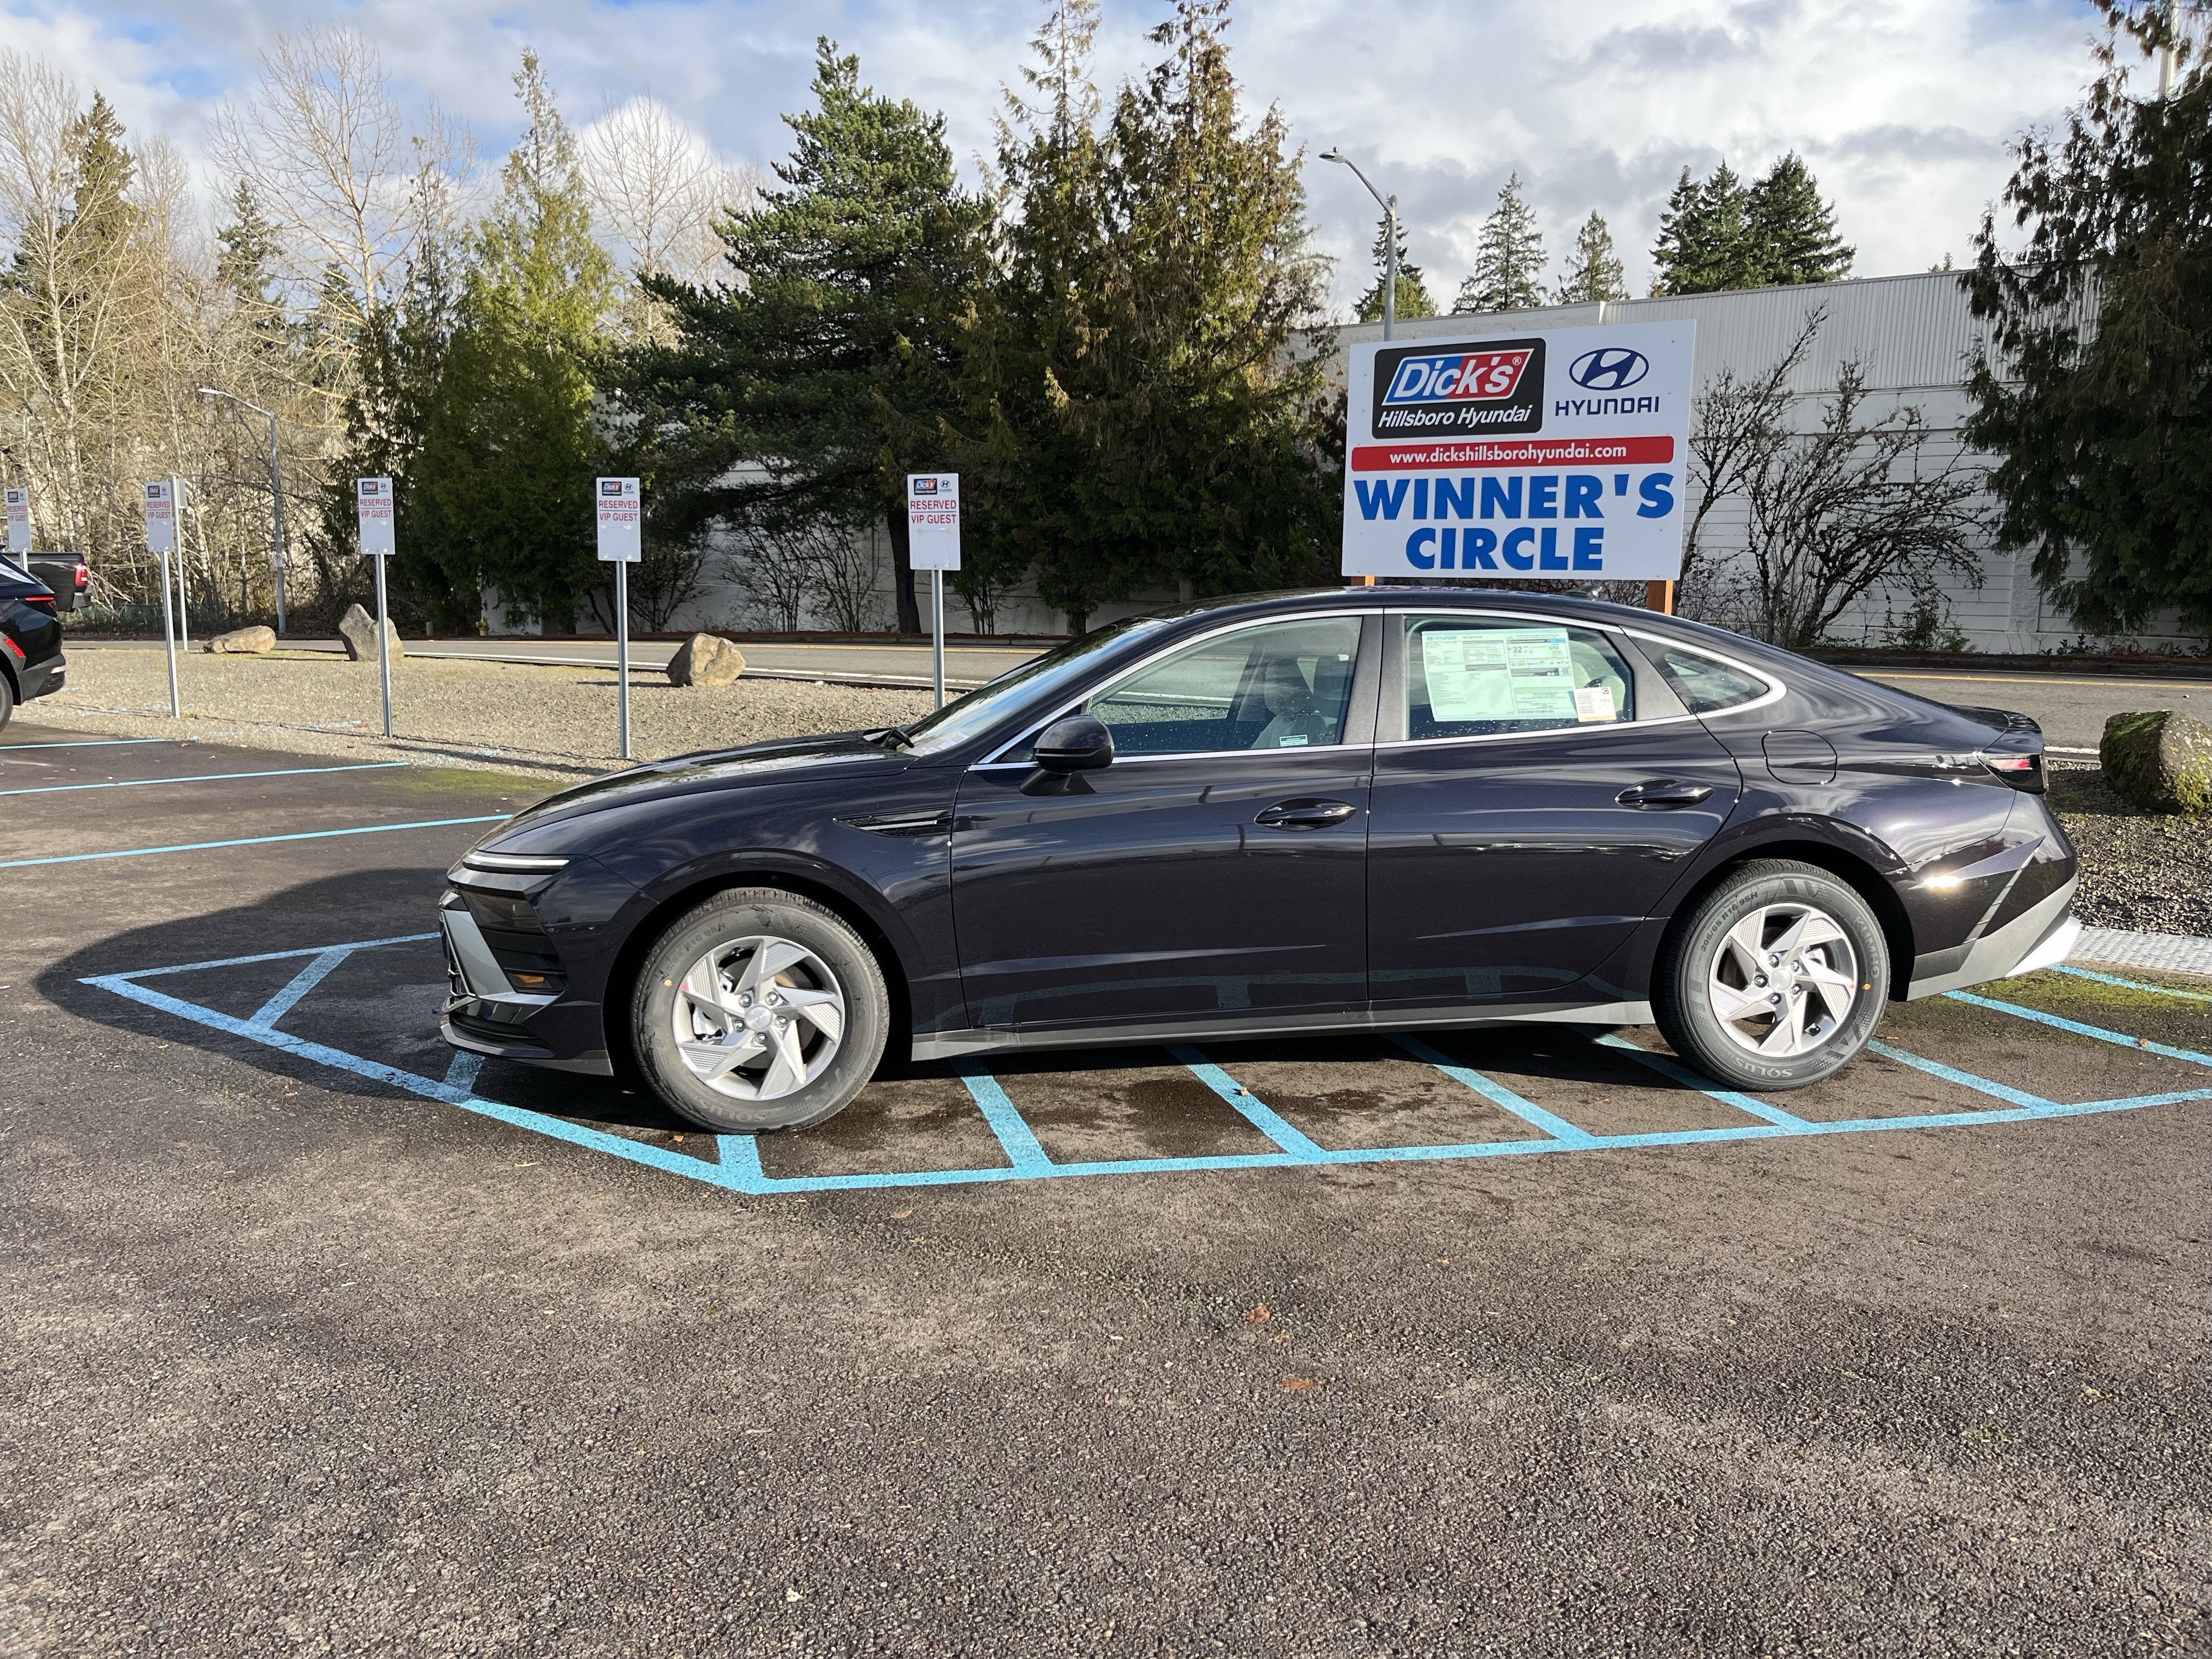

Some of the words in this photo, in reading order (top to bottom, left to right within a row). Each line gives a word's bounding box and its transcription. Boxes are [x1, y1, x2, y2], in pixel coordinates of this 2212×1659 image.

[1393, 357, 1514, 398] Dick's
[1377, 409, 1455, 427] Hillsboro
[1457, 405, 1533, 428] Hyundai
[1555, 396, 1659, 416] HYUNDAI
[1390, 442, 1627, 464] www.dickshillsborohyundai.com
[599, 500, 638, 509] RESERVED
[910, 500, 956, 510] RESERVED
[1353, 472, 1674, 520] WINNER'S
[613, 513, 637, 521] GUEST
[911, 515, 924, 523] VIP
[927, 514, 956, 523] GUEST
[1406, 527, 1604, 571] CIRCLE
[1854, 916, 1880, 978] KUMHO
[1733, 1057, 1793, 1078] SOLUS
[696, 1098, 766, 1122] SOLUS
